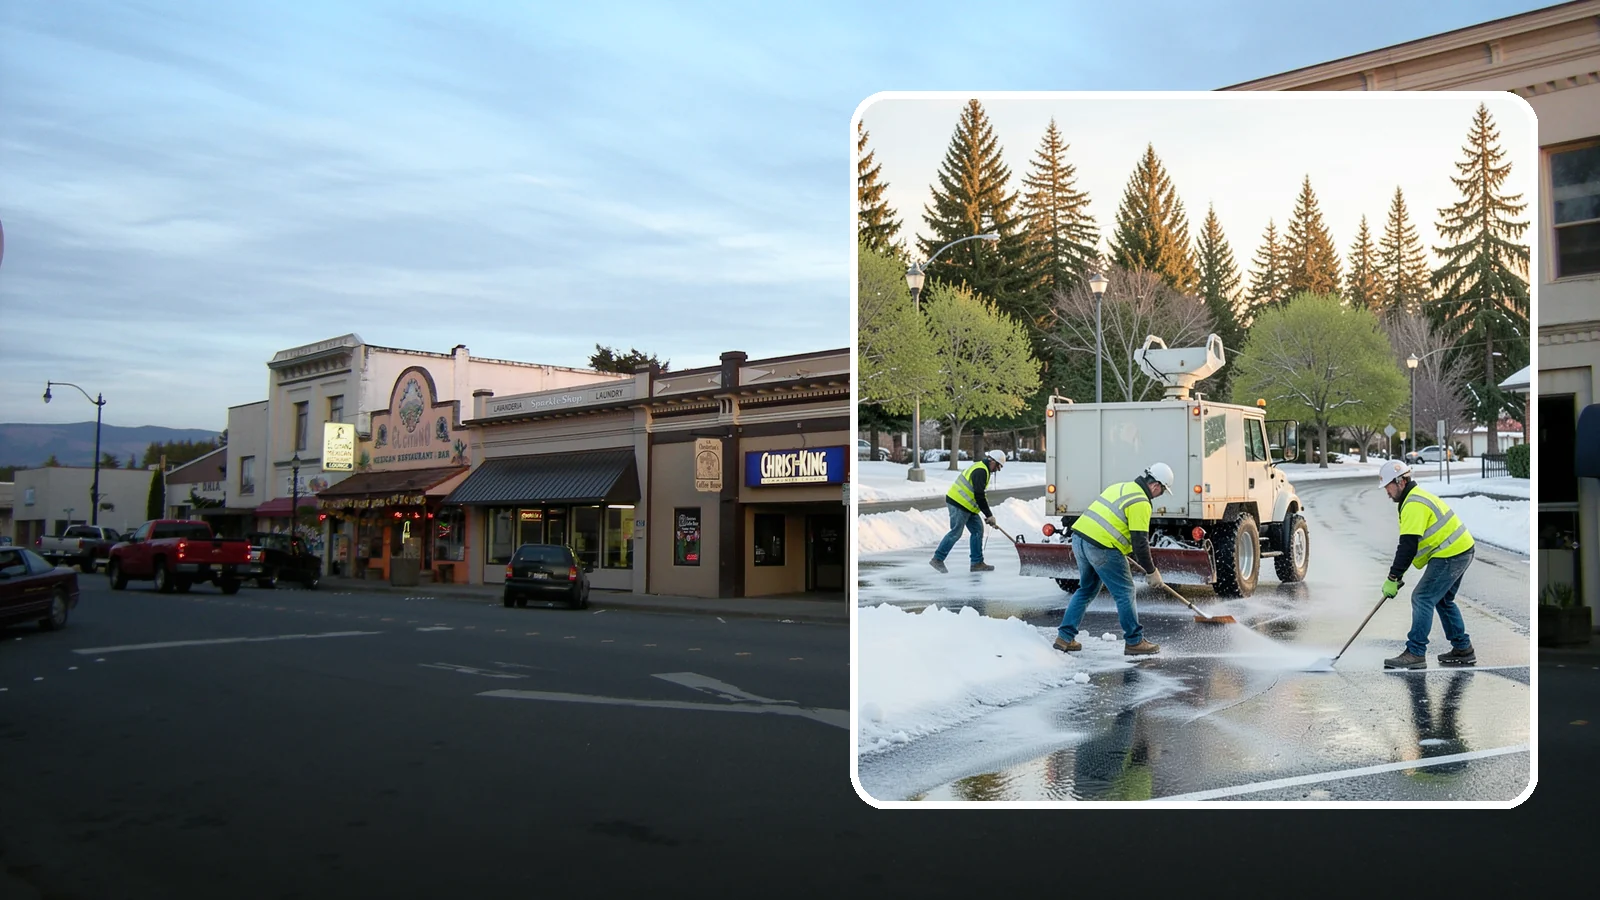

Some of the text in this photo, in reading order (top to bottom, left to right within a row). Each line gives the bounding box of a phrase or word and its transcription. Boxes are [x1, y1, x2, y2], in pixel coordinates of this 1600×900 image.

[530, 394, 583, 409] Sparkle Shop
[595, 389, 623, 400] LAUNDRY
[493, 402, 522, 413] LAVANDERIA
[374, 455, 396, 464] MEXICAN
[397, 451, 434, 462] RESTAURANT
[438, 450, 450, 459] BAR
[761, 450, 828, 478] CHRIST KING
